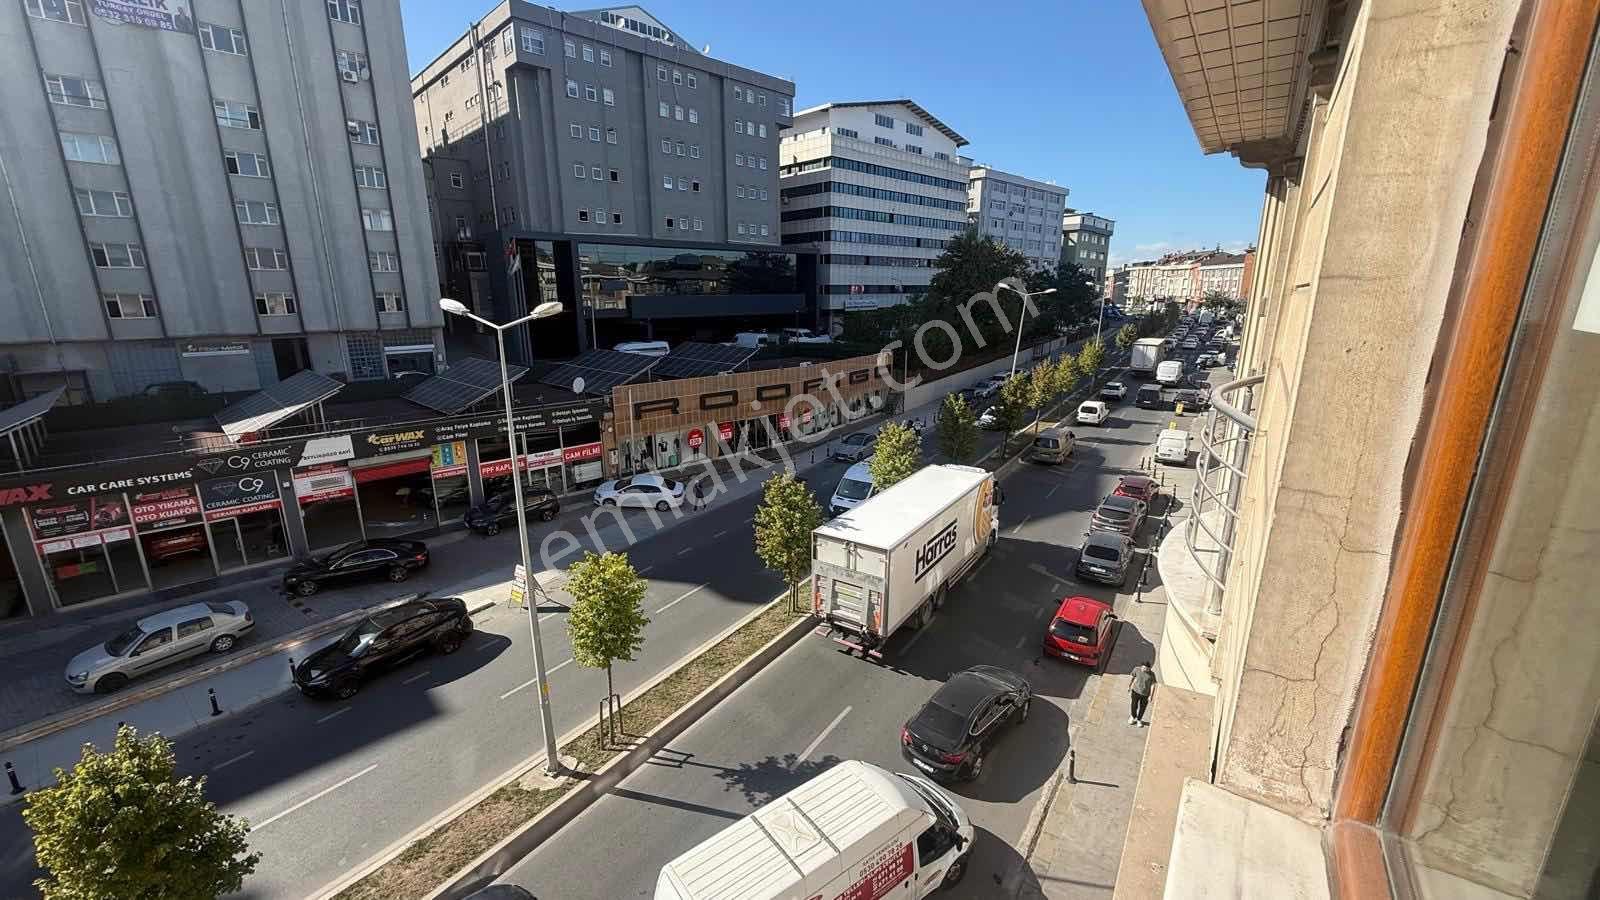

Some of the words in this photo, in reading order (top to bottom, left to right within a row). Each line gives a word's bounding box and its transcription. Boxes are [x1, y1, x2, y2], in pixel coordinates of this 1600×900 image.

[227, 455, 251, 470] C9
[252, 448, 289, 460] CERAMIC
[254, 457, 291, 469] COATING
[565, 451, 580, 460] CAM
[67, 484, 96, 495] CAR
[99, 479, 135, 491] CARE
[136, 471, 192, 485] SYSTEMS
[238, 477, 264, 493] C9
[134, 504, 156, 514] OTO
[157, 499, 196, 511] YIKAMA
[206, 498, 241, 509] CERAMIC
[242, 494, 274, 503] COATING
[135, 513, 157, 523] OTO
[915, 522, 957, 575] Harras
